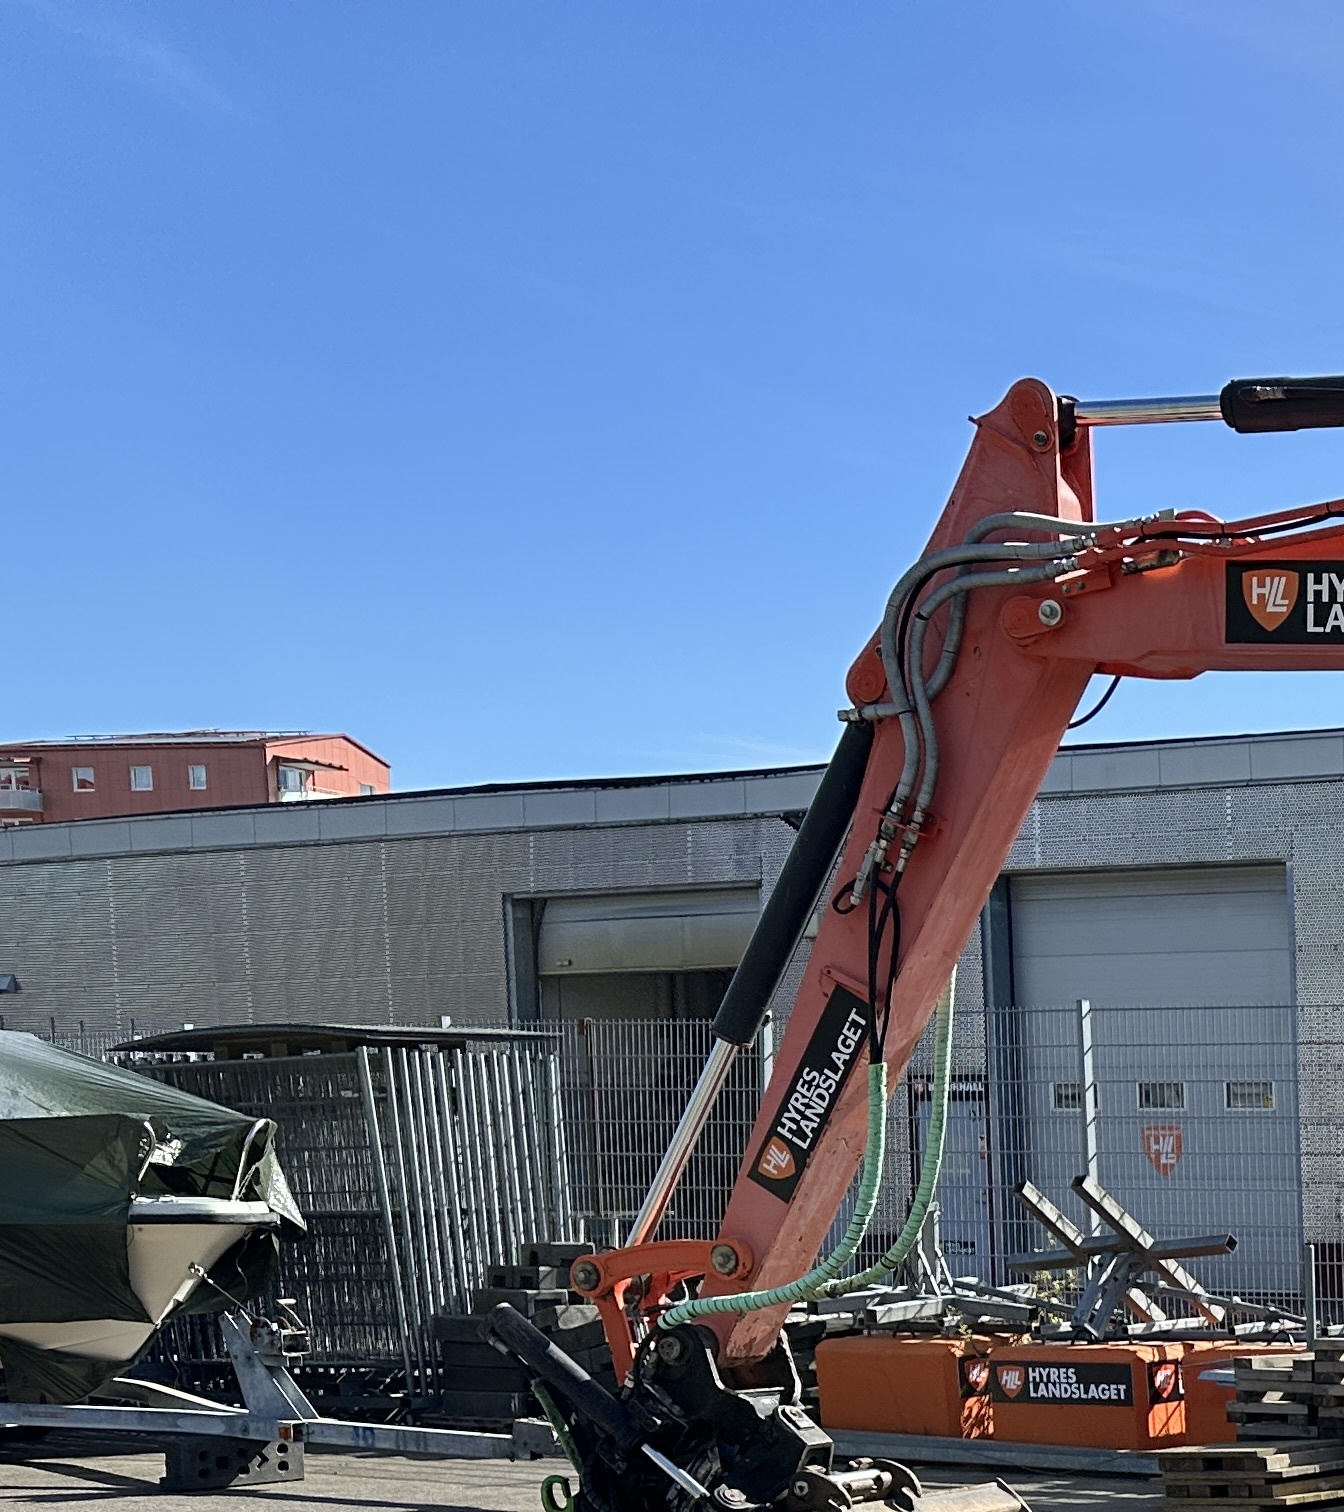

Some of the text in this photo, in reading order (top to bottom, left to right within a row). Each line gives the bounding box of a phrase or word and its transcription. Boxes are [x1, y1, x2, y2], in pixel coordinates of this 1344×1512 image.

[1251, 576, 1289, 613] HLL
[791, 1008, 867, 1150] LANDSLAGET
[777, 1067, 820, 1140] HYRES
[1028, 1367, 1076, 1383] HYRES
[1029, 1382, 1126, 1400] LANDSLAGET
